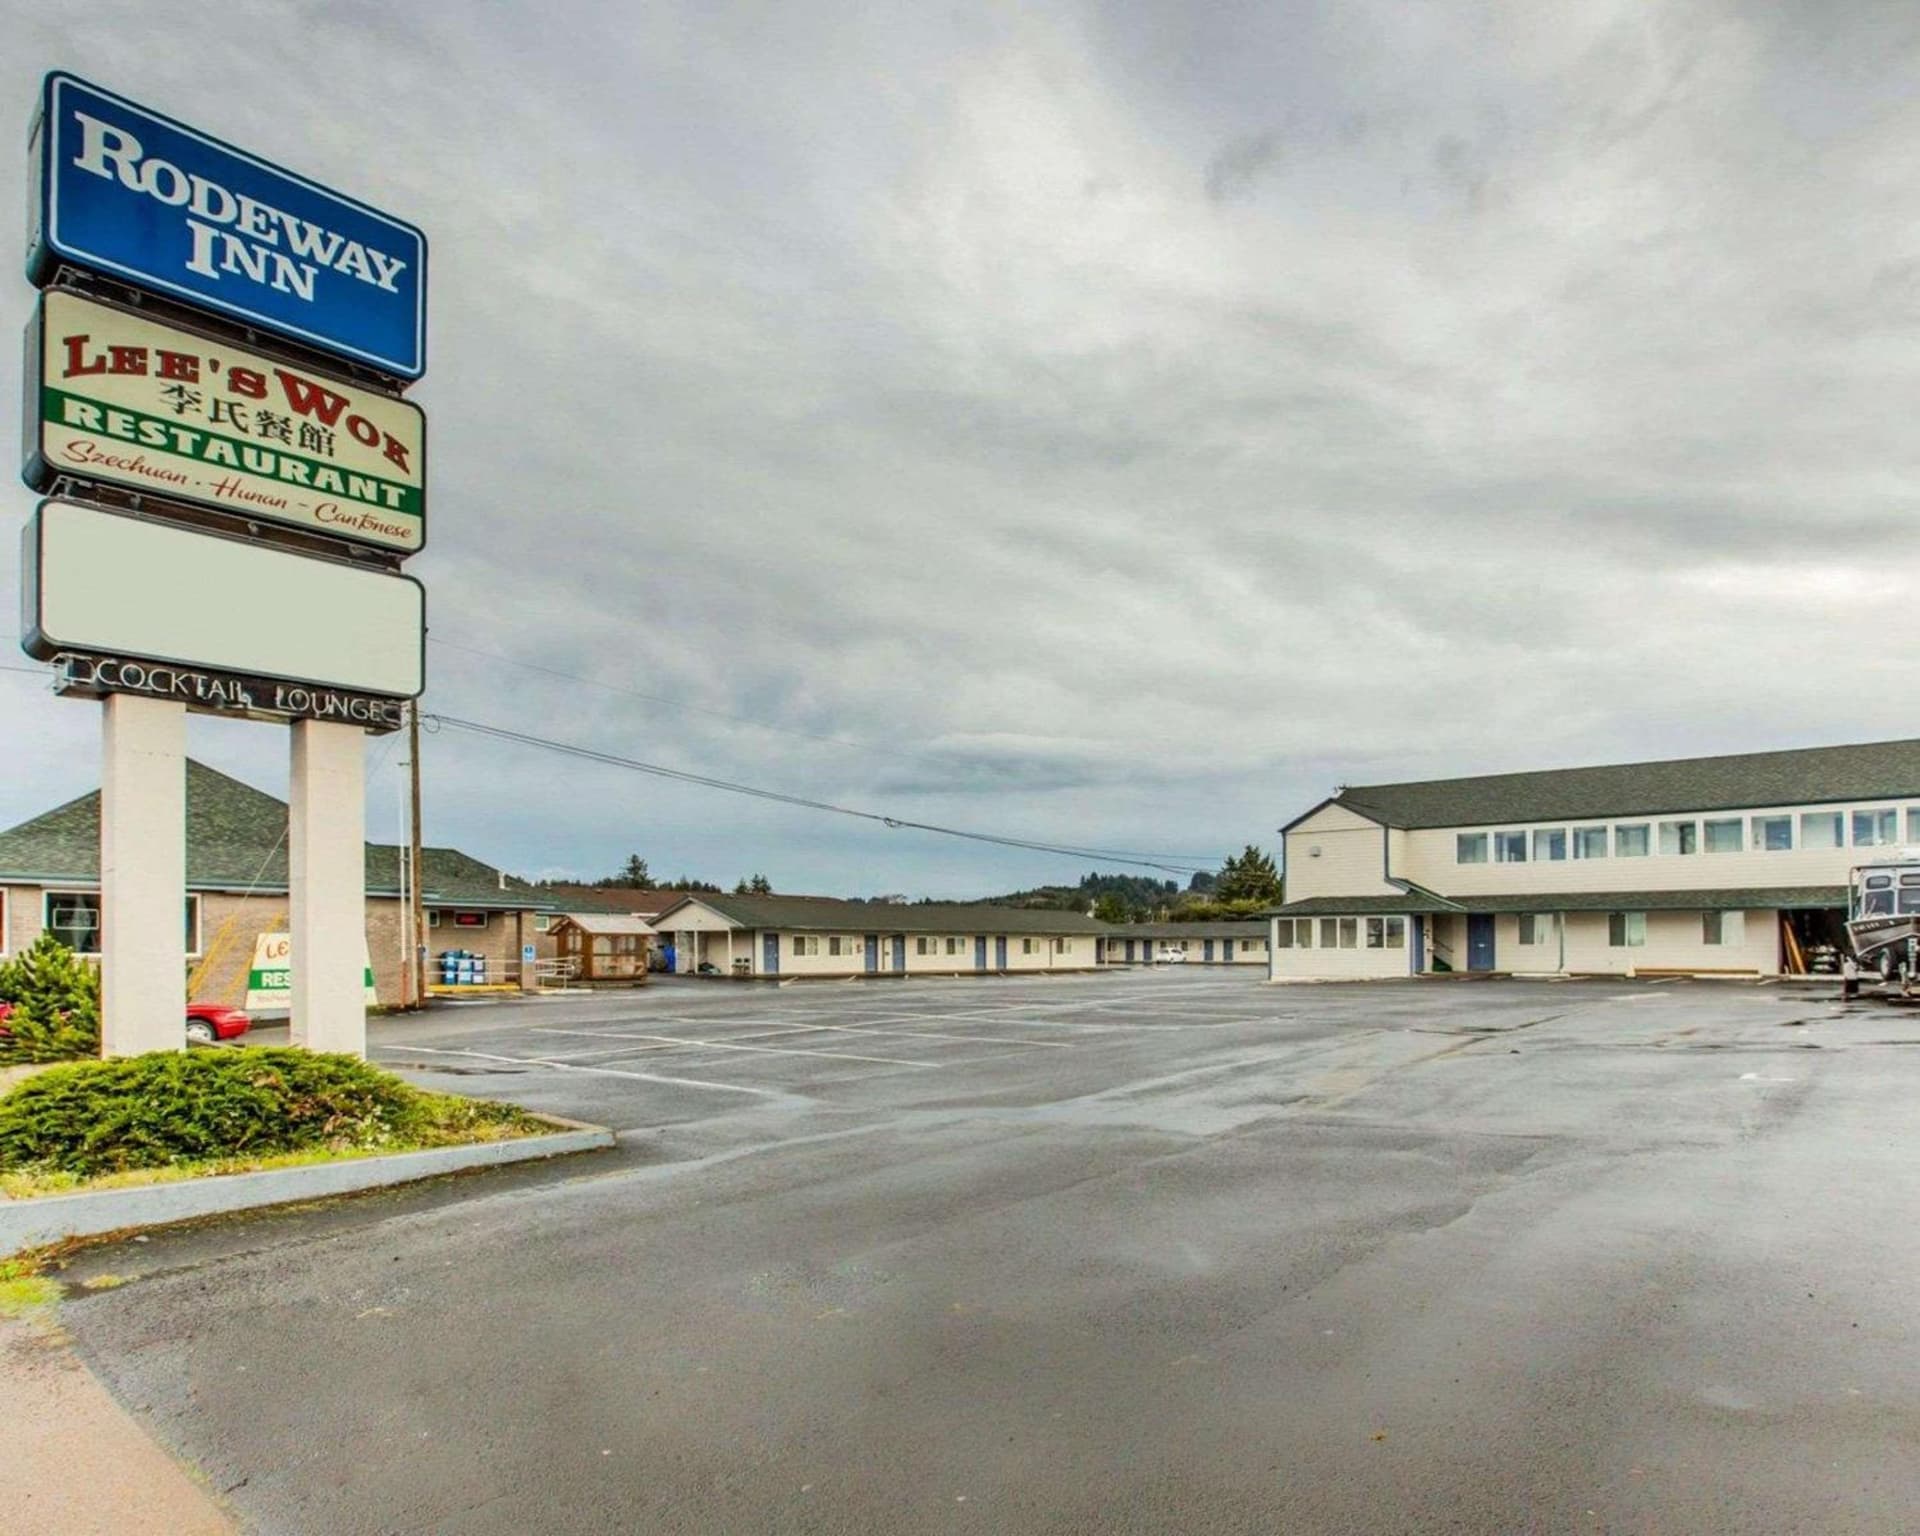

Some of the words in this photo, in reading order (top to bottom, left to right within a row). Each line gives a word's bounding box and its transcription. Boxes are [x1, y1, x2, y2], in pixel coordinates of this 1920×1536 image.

[74, 111, 406, 293] RODEWAY
[185, 219, 319, 302] INN
[63, 334, 268, 400] LEE'S
[274, 368, 411, 475] WOK
[64, 397, 406, 508] RESTAURANT
[159, 382, 337, 457] 李氏餐館
[61, 440, 187, 486] Szechuan
[210, 476, 288, 509] Hunan
[315, 502, 413, 539] Cantonese
[97, 659, 251, 704] COCKTAIL
[276, 686, 382, 722] LOUNGE
